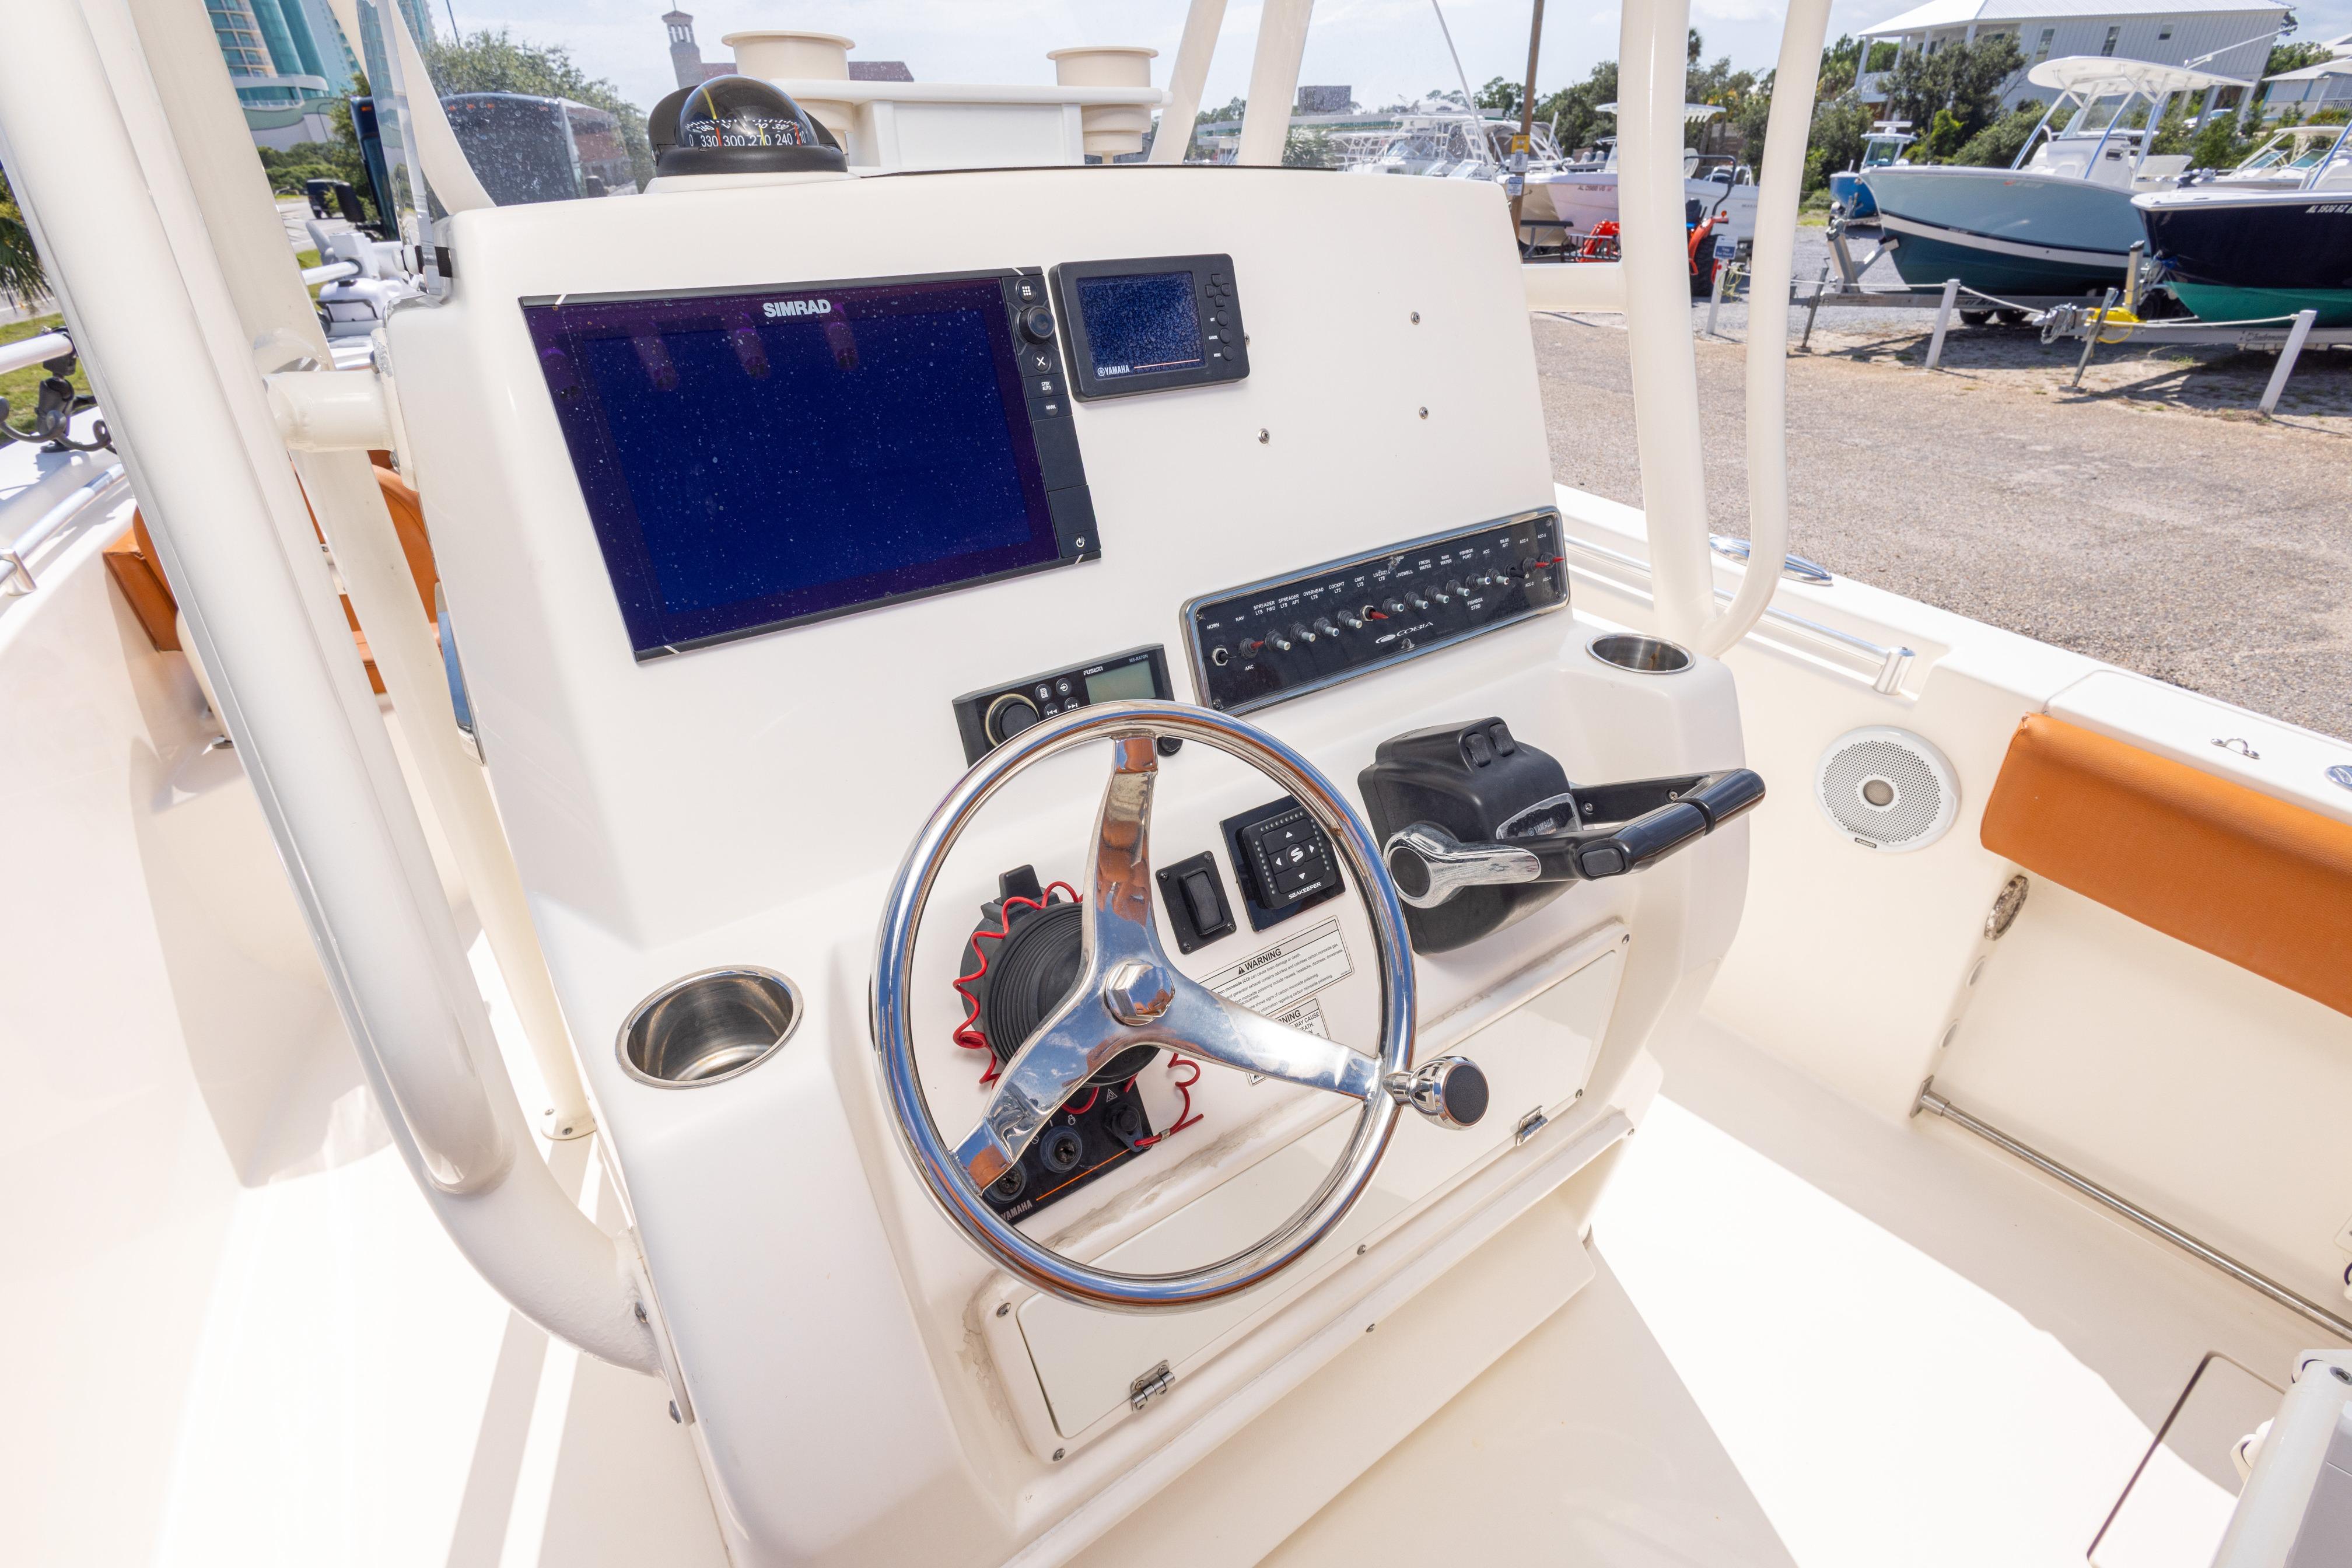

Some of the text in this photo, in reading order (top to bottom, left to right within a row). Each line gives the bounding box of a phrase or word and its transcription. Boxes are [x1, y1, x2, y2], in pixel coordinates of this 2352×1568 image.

[701, 135, 719, 147] 330
[723, 135, 745, 146] 300
[749, 134, 771, 146] 270
[775, 133, 793, 145] 240
[763, 299, 831, 318] SIMRAD
[1104, 365, 1130, 375] YAMAHA
[1303, 587, 1324, 597] OVERHEAD
[1328, 582, 1345, 590] COCKPIT
[1253, 600, 1275, 611] SPREADER
[1278, 594, 1299, 604] SPREADER
[1467, 597, 1483, 606] FISHBOX
[1396, 622, 1434, 636] COBIA
[1129, 654, 1148, 663] MS-RA70N
[1534, 817, 1554, 834] YAMAHA
[1288, 881, 1321, 899] SEAKEEPER
[1245, 949, 1282, 971] WARNING
[1233, 986, 1248, 998] generator
[1248, 980, 1261, 989] exhaust
[1261, 974, 1275, 983] contains
[1274, 968, 1288, 977] odorless
[1294, 958, 1308, 967] colorless
[1318, 946, 1332, 955] monoxide
[1225, 981, 1242, 992] monoxide
[1241, 991, 1258, 1000] monoxide
[1257, 983, 1273, 993] poisoning
[1272, 978, 1284, 986] include
[1289, 981, 1304, 990] monoxide
[1261, 1002, 1278, 1013] information
[1278, 994, 1293, 1004] regarding
[1303, 982, 1318, 991] monoxide
[1294, 1012, 1320, 1027] MAY CAUSE
[1001, 1199, 1032, 1220] YAMAHA
